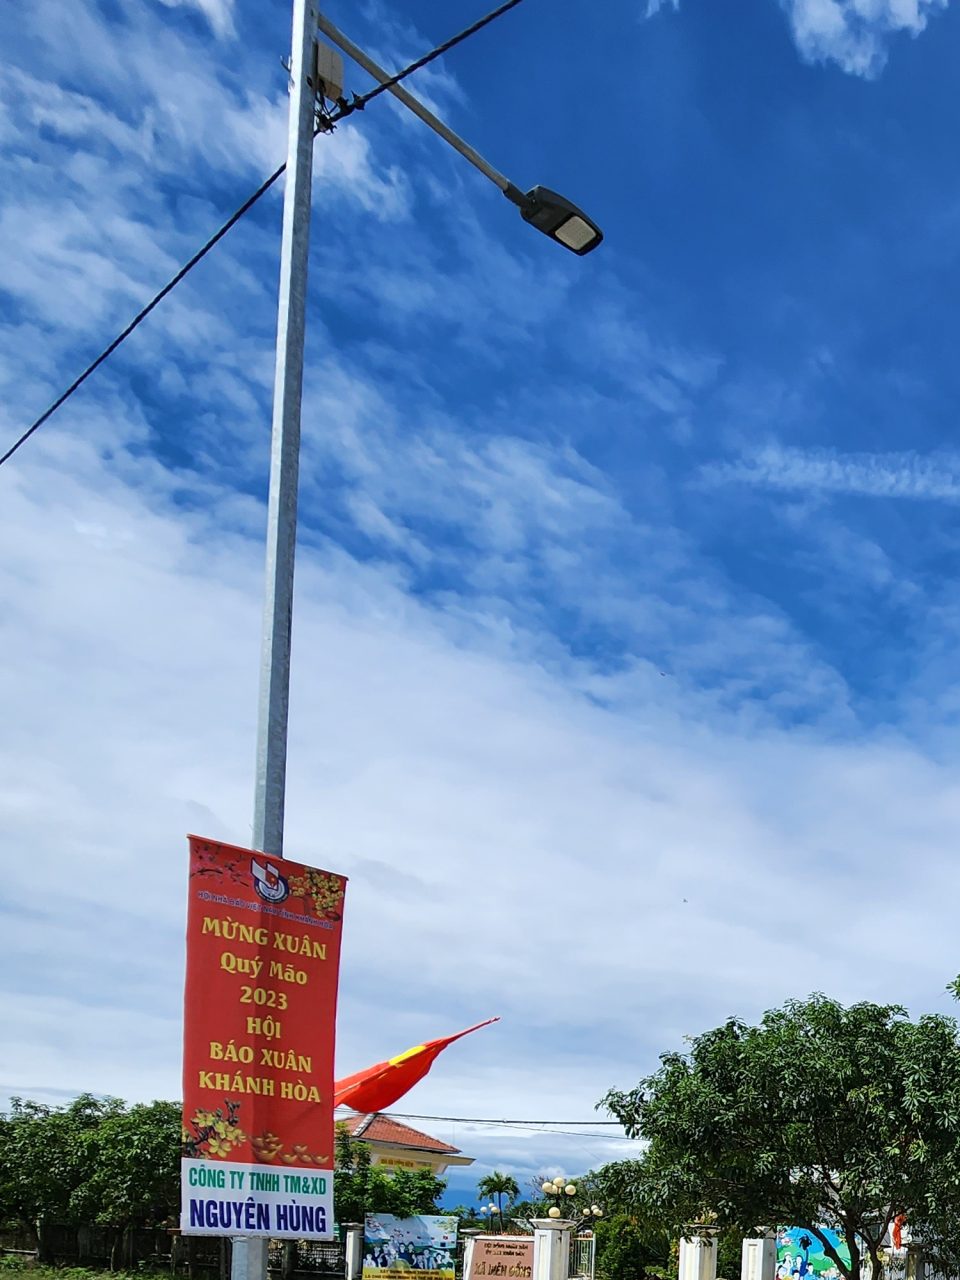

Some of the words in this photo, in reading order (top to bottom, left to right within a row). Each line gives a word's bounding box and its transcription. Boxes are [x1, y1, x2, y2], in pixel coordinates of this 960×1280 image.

[202, 916, 268, 945] MỪNG
[273, 932, 327, 960] XUÂN
[220, 952, 264, 979] Quý
[269, 960, 308, 985] Mão
[240, 986, 288, 1011] 2023
[246, 1015, 281, 1041] HỘI
[209, 1039, 254, 1064] BÁO
[260, 1048, 312, 1073] XUÂN
[198, 1070, 274, 1097] KHÁNH
[280, 1079, 321, 1103] HÒA
[188, 1164, 225, 1189] CÔNG
[229, 1170, 244, 1190] TY
[248, 1172, 280, 1192] TNHH
[283, 1174, 327, 1196] TM&XD
[190, 1196, 270, 1231] NGUYÊN
[276, 1199, 327, 1233] HÙNG
